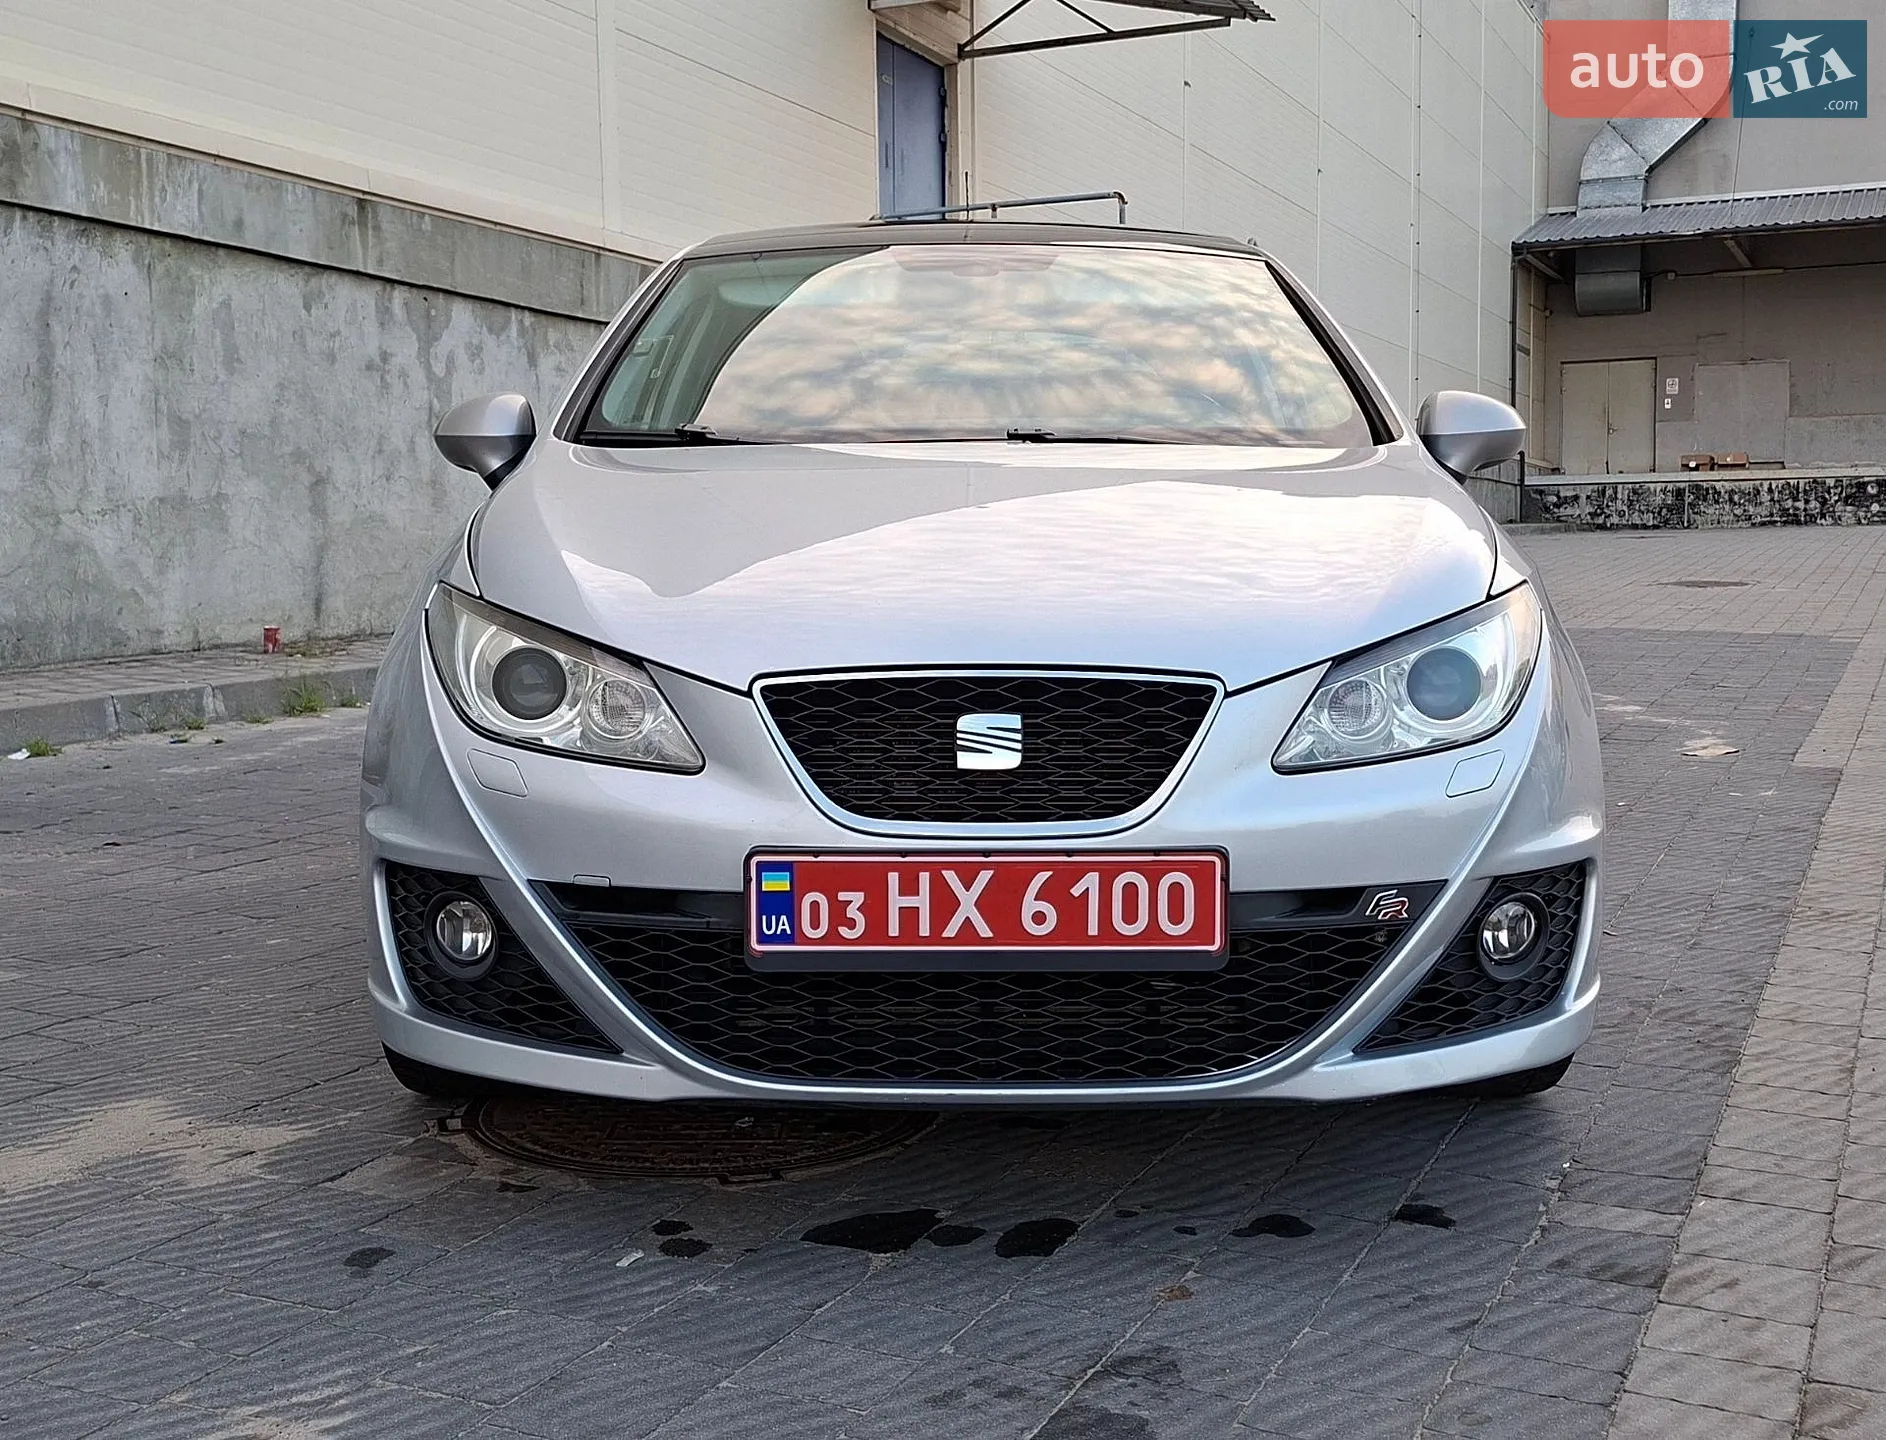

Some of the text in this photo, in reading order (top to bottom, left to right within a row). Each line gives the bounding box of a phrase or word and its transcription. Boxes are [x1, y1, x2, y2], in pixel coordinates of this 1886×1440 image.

[761, 914, 792, 935] UA
[801, 869, 1197, 940] 03 HX 6100
